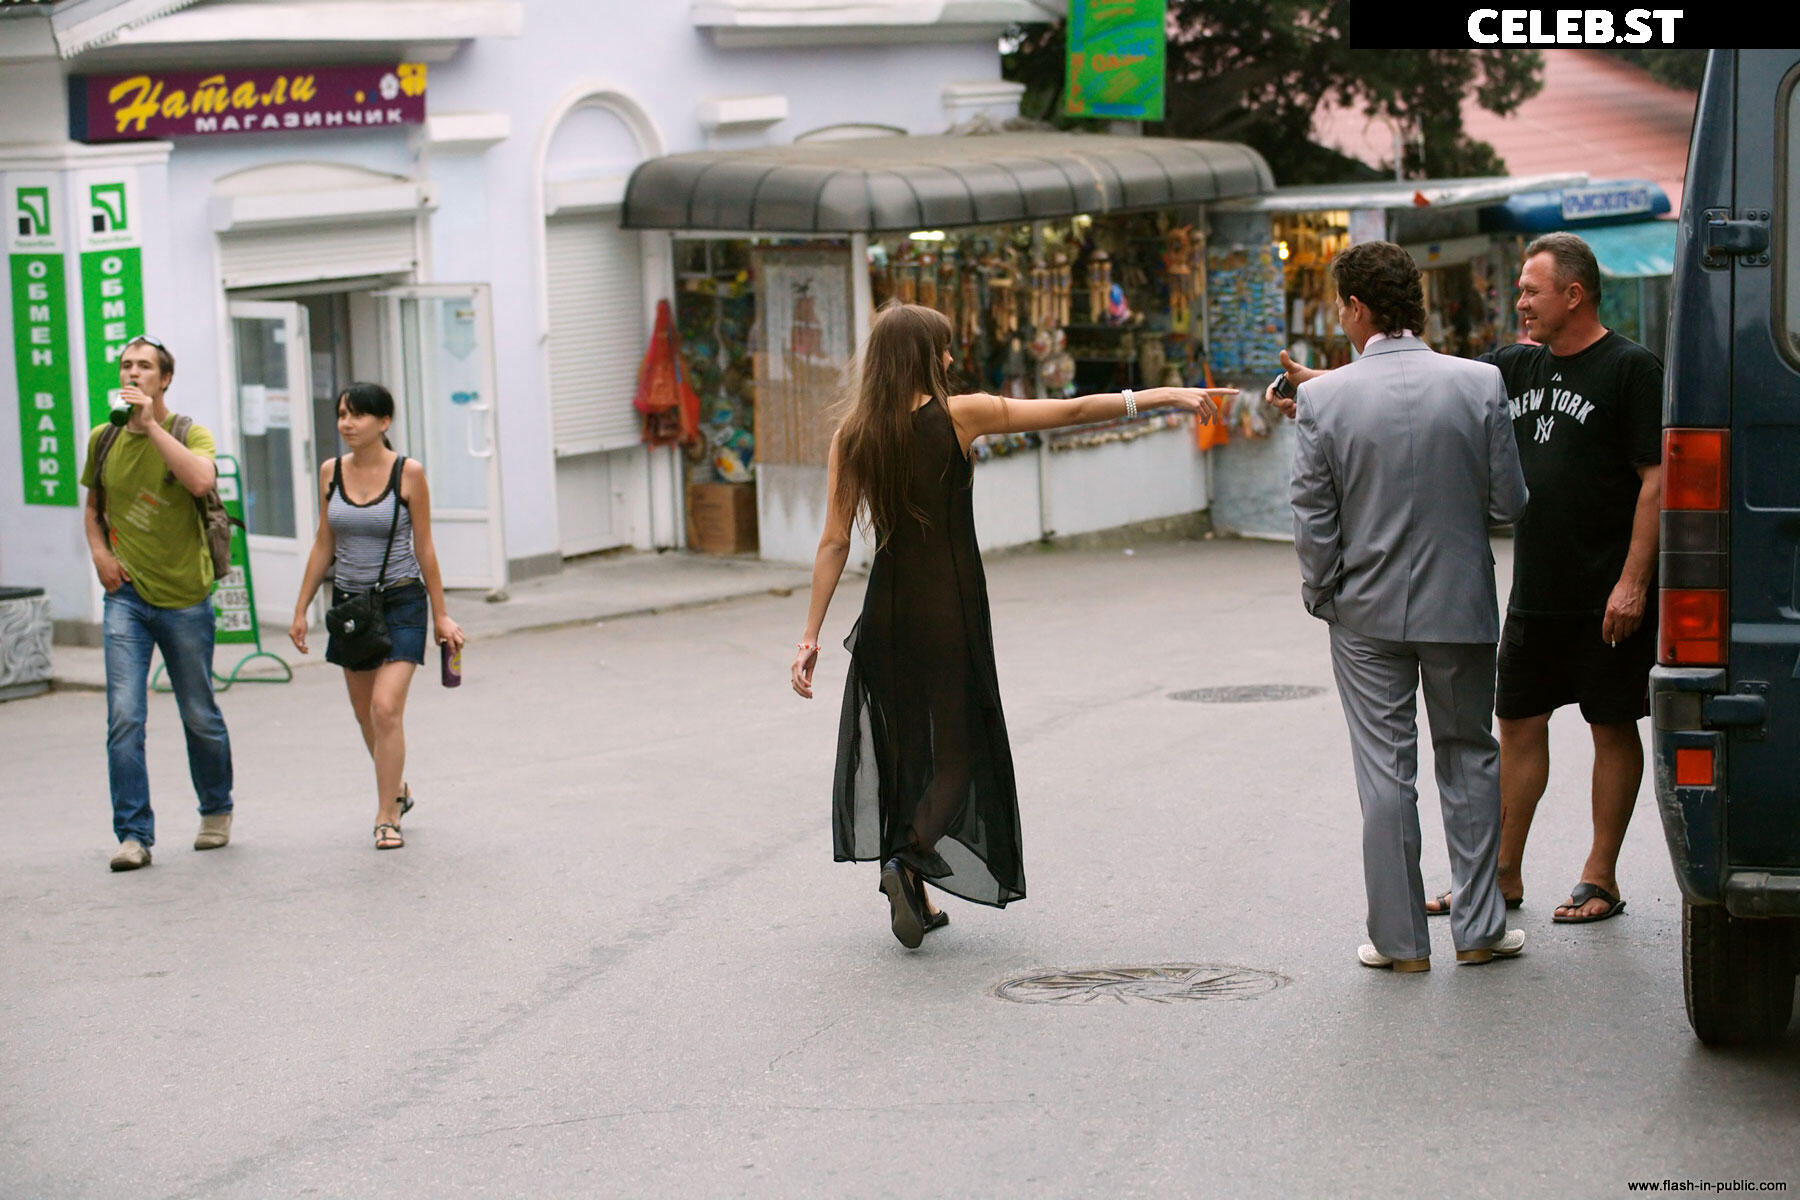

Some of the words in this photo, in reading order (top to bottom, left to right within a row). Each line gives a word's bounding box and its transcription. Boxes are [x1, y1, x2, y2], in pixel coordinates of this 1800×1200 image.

[107, 74, 317, 133] Натали
[194, 108, 402, 133] МАГАЗИНЧИК
[27, 260, 53, 366] ОБМЕН
[1508, 387, 1545, 420] NEW
[1550, 388, 1595, 425] YORK
[34, 392, 60, 498] ВАЛЮТ
